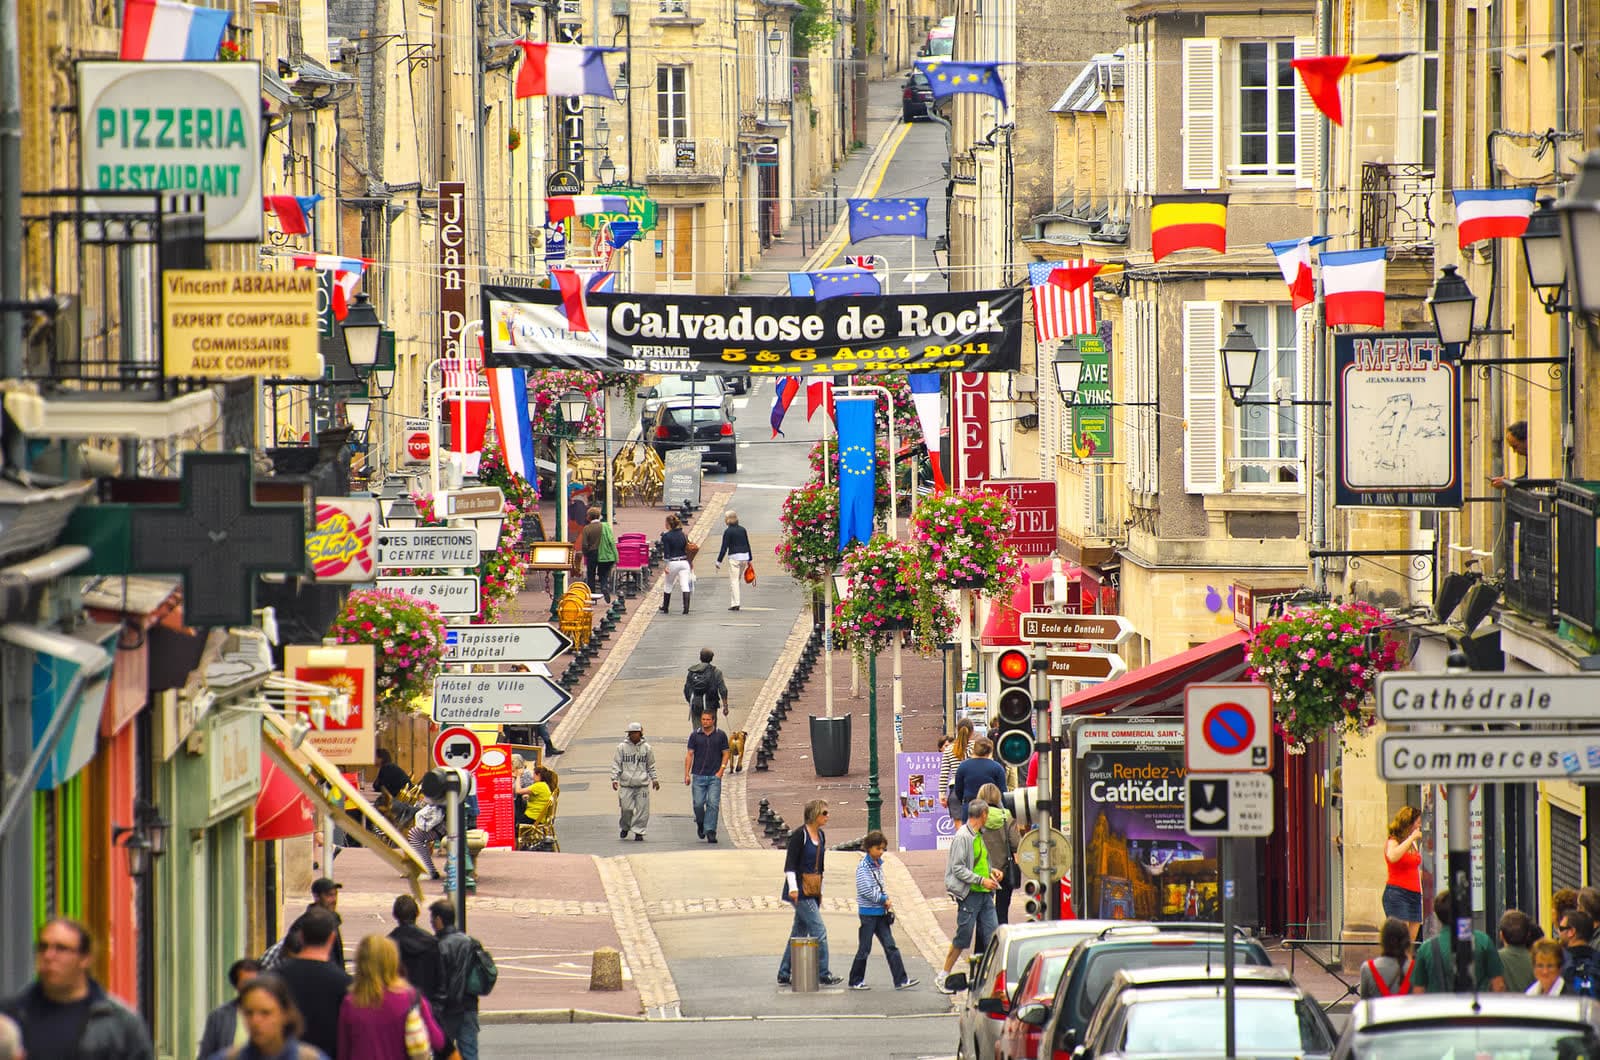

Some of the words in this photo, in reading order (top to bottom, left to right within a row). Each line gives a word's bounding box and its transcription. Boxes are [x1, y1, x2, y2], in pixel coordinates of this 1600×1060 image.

[97, 108, 246, 148] PIZZERIA
[98, 165, 240, 196] RESTAURANT
[441, 193, 463, 290] Jean
[169, 276, 226, 294] Vincent
[231, 276, 312, 294] ABRAHAM
[172, 312, 221, 327] EXPERT
[226, 312, 309, 327] COMPTABLE
[611, 302, 824, 342] Calvadose
[837, 306, 886, 340] de
[897, 300, 1003, 337] Rock
[191, 336, 289, 351] COMMISSAIRE
[631, 344, 690, 359] FERME
[721, 348, 748, 362] 5
[755, 349, 781, 362] &
[790, 348, 817, 361] 6
[832, 345, 911, 361] Août
[923, 342, 991, 358] 2011
[1353, 338, 1443, 372] IMPACT
[191, 355, 221, 369] AUX
[225, 355, 289, 370] COMPTES
[623, 360, 646, 371] DE
[649, 360, 701, 372] SULLY
[1080, 363, 1108, 383] AVE
[1084, 389, 1112, 407] VINS
[1012, 509, 1055, 533] TEL
[306, 535, 358, 560] Shop
[389, 536, 407, 546] TES
[413, 535, 473, 546] DIRECTIONS
[389, 550, 435, 561] CENTRE
[441, 549, 473, 560] VILLE
[410, 585, 423, 595] de
[429, 584, 469, 597] Séjour
[1041, 623, 1061, 633] Ecole
[1063, 624, 1073, 633] de
[1074, 624, 1105, 634] Dentelle
[461, 632, 520, 646] Tapisserie
[461, 646, 505, 659] Hôpital
[1052, 661, 1070, 670] Poste
[440, 680, 471, 691] Hôtel
[477, 681, 490, 691] de
[497, 681, 525, 691] Ville
[440, 693, 484, 704] Musées
[1392, 687, 1552, 711] Cathédrale
[440, 706, 501, 718] Cathédrale
[1393, 746, 1559, 770] Commerces
[1112, 762, 1187, 780] Rendez-v
